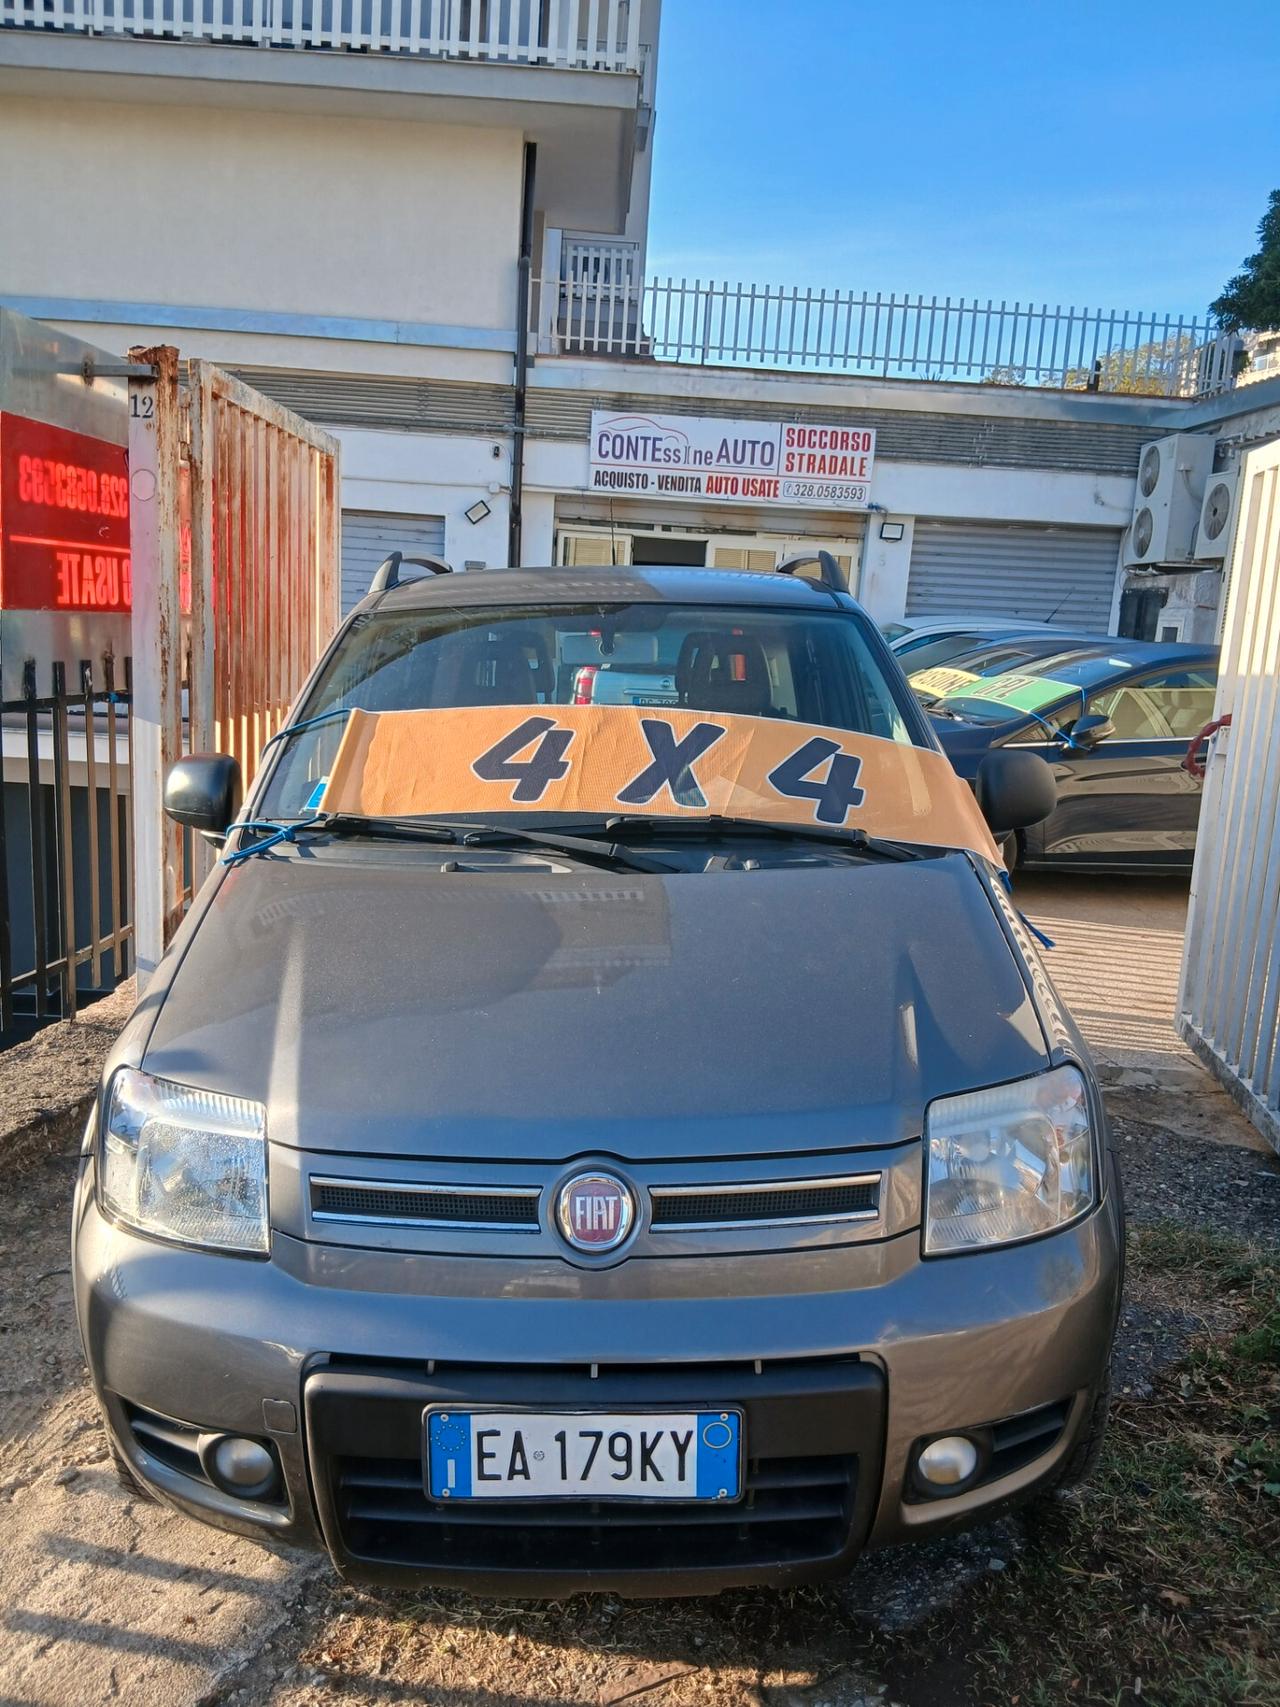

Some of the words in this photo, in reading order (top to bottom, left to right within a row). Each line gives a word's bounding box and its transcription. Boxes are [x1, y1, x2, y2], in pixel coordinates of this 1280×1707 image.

[130, 393, 154, 419] 12
[716, 438, 775, 467] AUTO
[786, 427, 872, 453] SOCCORSO
[785, 452, 868, 477] STRADALE
[594, 470, 649, 490] ACQUISTO
[657, 474, 702, 493] VENDITA
[706, 475, 739, 496] AUTO
[742, 477, 779, 498] USATE
[793, 483, 865, 500] 328.0583593
[470, 716, 576, 803] 4
[615, 718, 727, 808] X
[766, 736, 866, 825] 4
[575, 1196, 618, 1230] FIAT
[476, 1430, 531, 1481] EA
[554, 1430, 694, 1482] 179KY
